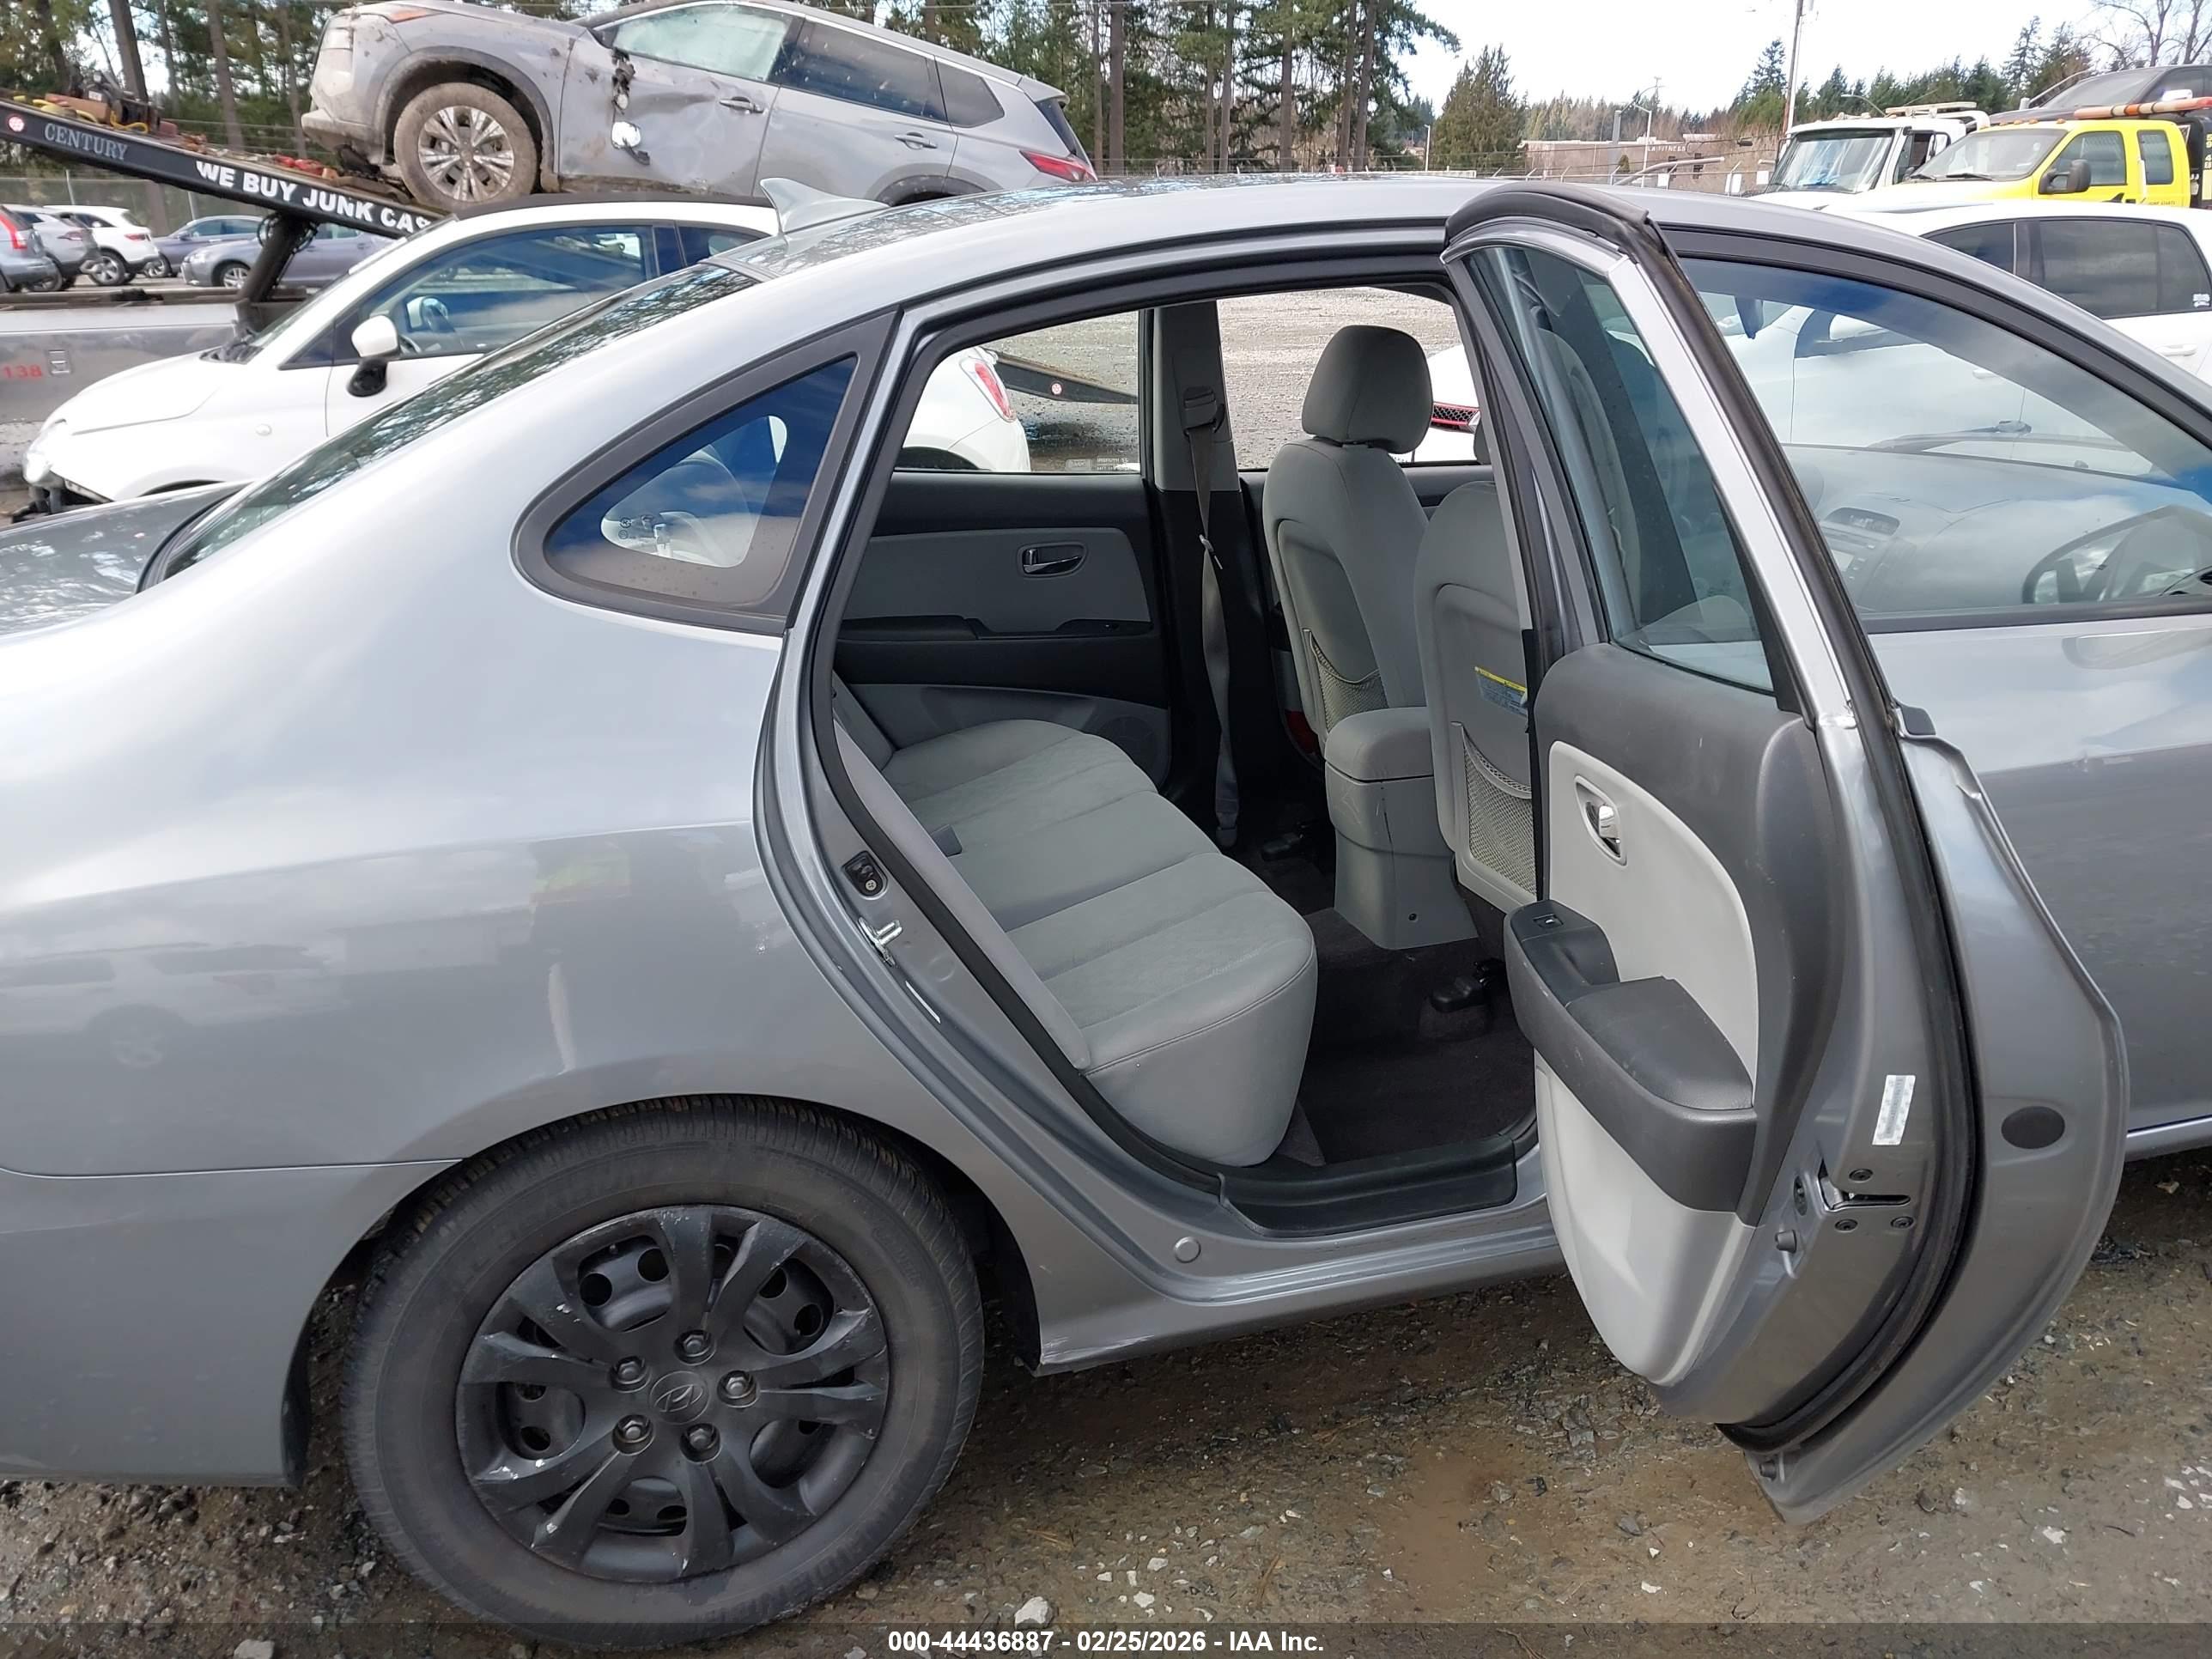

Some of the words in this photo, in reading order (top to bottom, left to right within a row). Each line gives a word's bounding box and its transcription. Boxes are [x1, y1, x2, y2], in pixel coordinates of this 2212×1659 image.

[44, 123, 127, 161] CENTURY
[196, 160, 235, 188] WE
[242, 172, 298, 202] BUY
[302, 188, 374, 222] JUNK
[3, 364, 42, 378] 138
